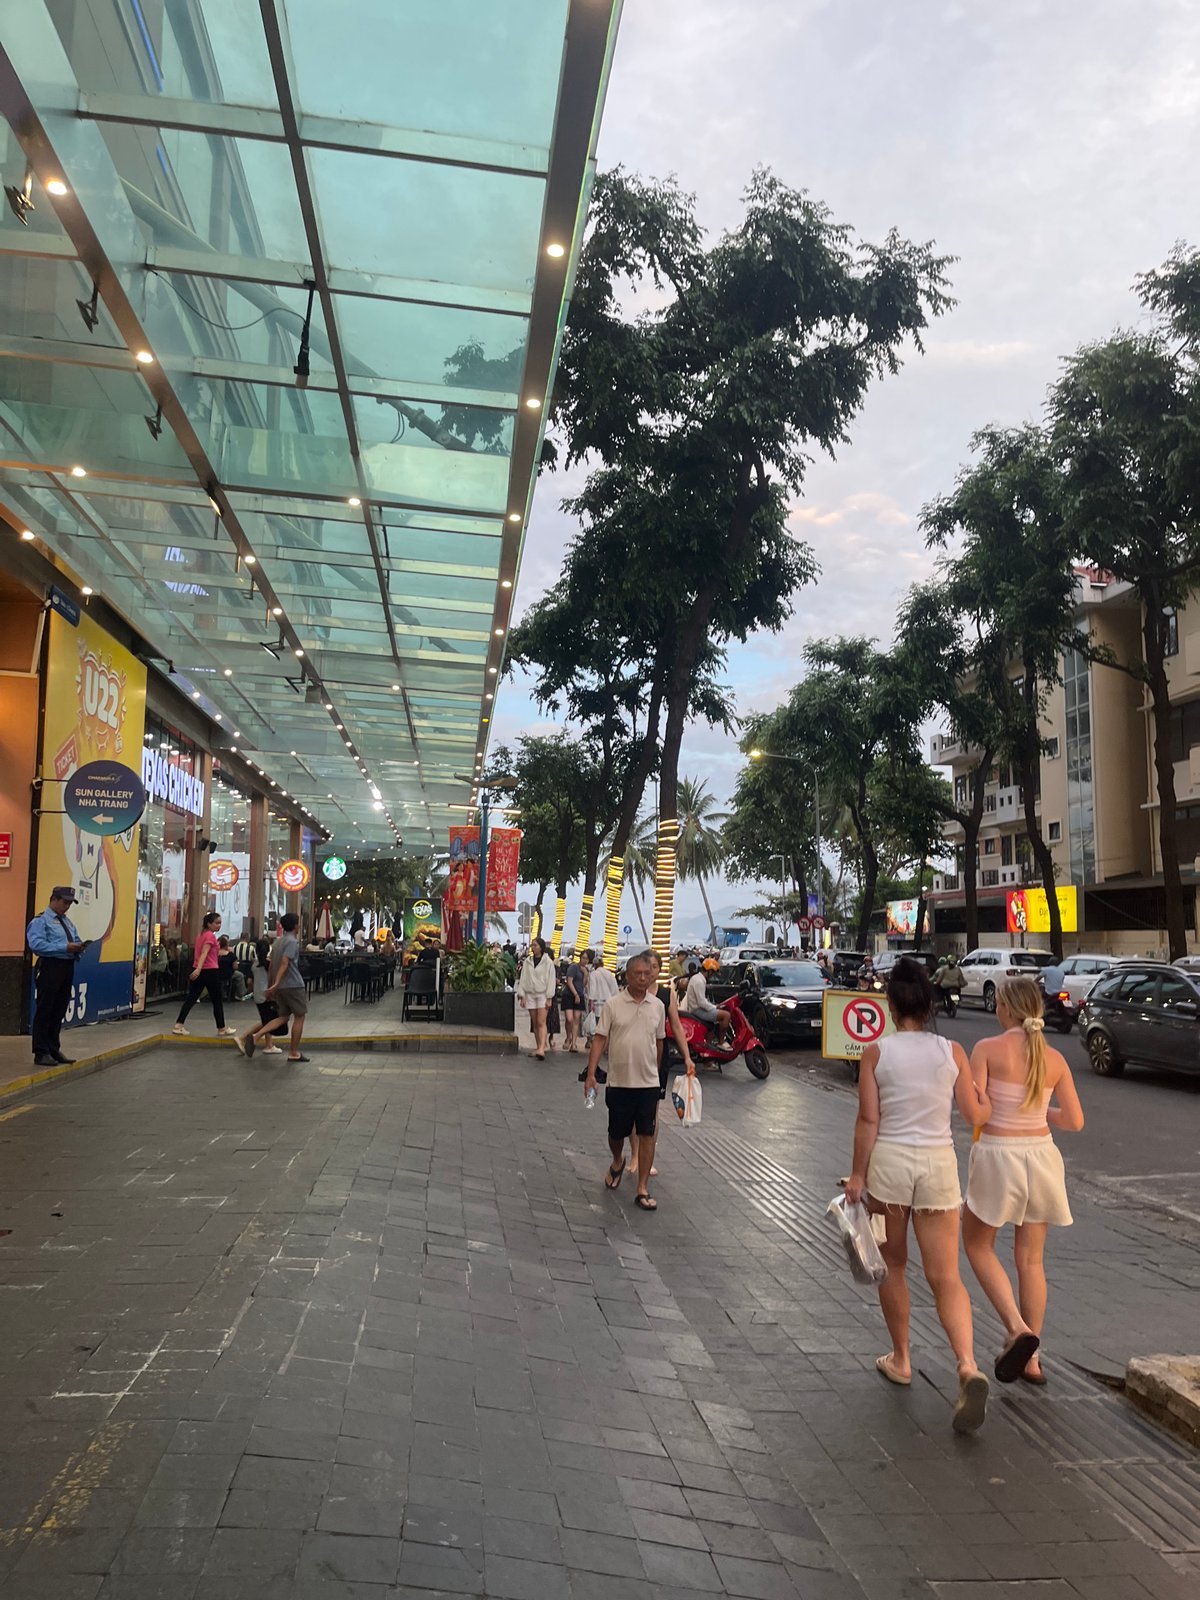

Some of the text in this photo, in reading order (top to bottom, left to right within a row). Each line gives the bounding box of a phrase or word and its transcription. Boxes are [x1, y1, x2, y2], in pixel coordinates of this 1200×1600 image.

[85, 665, 119, 729] U22
[57, 745, 75, 774] TICKET
[75, 788, 134, 799] SUN GALLERY
[142, 746, 204, 818] TEXAS CHICKEN
[78, 798, 129, 809] NHA TRANG
[412, 904, 432, 916] TEXAS
[77, 982, 88, 1020] 3
